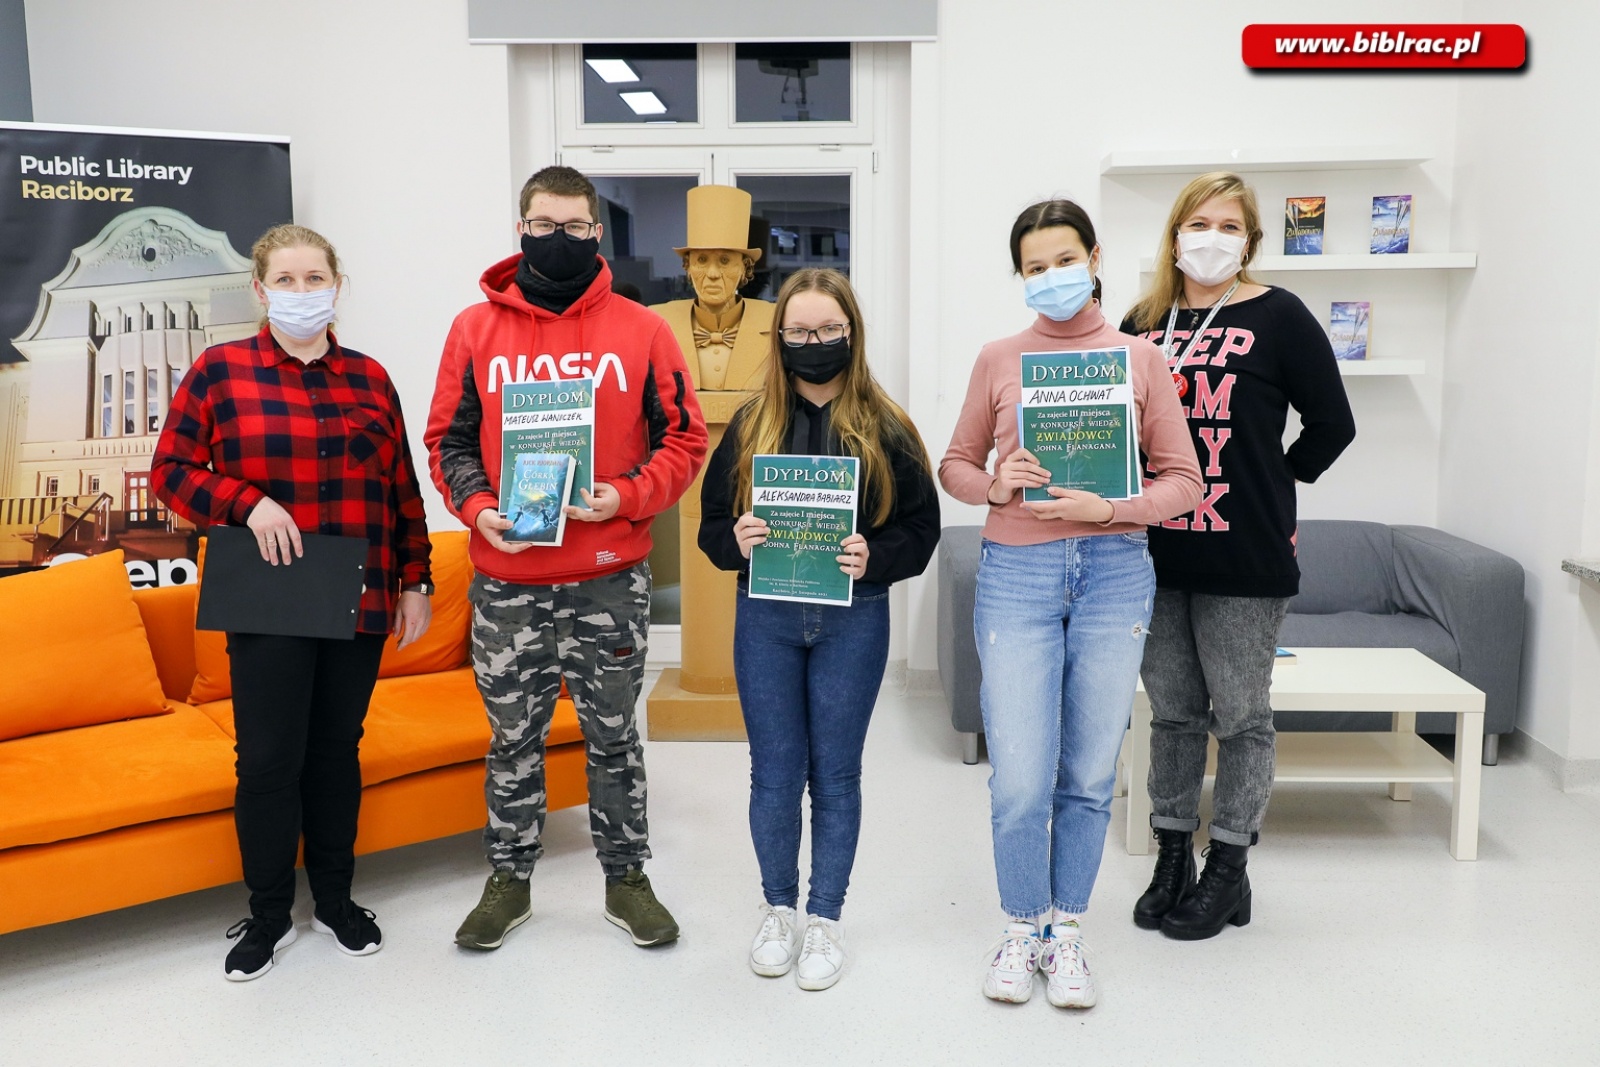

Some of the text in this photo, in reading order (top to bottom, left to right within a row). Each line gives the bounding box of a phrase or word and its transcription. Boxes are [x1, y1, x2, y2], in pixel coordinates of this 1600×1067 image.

[20, 155, 193, 185] Public Library
[22, 180, 134, 202] Raciborz
[487, 352, 627, 393] NASA
[1031, 364, 1117, 382] DYPLOM
[512, 391, 584, 408] DYPLOM
[1029, 387, 1114, 404] ANNA OCHWAT
[504, 414, 539, 425] MATEUSZ
[1080, 409, 1110, 418] miejsca
[763, 466, 847, 484] DYPLOM
[758, 489, 852, 504] ALEKSANDRA BABIARZ
[806, 510, 835, 520] miejsca
[763, 540, 790, 548] JOHNA
